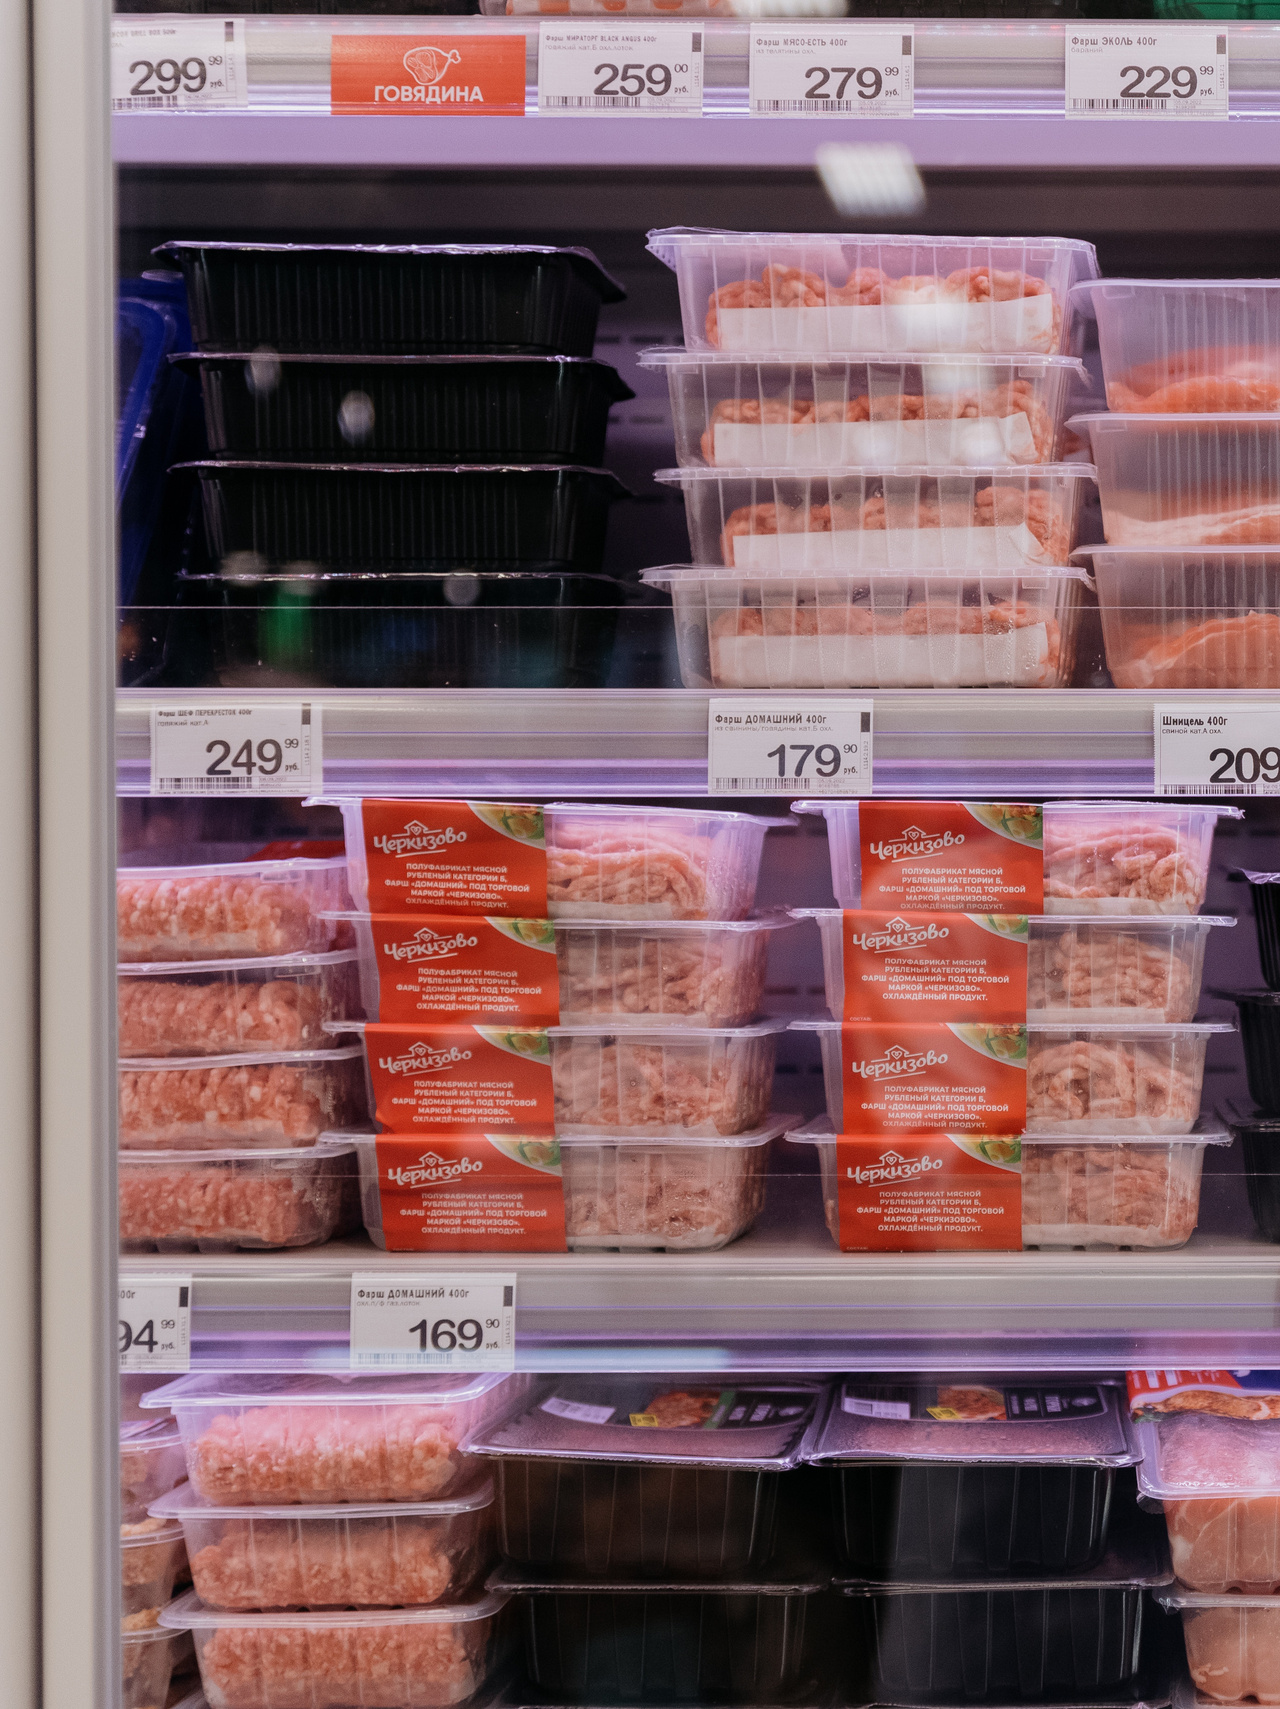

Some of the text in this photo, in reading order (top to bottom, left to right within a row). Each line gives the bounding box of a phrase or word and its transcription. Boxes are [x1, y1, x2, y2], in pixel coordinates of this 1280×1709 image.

[756, 39, 779, 47] Фарш
[1072, 37, 1098, 46] Фарш
[1102, 37, 1133, 45] ЭКОЛЬ
[130, 56, 222, 95] 299 99
[594, 63, 688, 96] 259 00
[805, 67, 899, 99] 279 99
[1120, 66, 1214, 98] 229 99
[375, 85, 483, 104] ГОВЯДИНА
[715, 715, 742, 724] Фарш
[745, 714, 802, 724] ДОМАШНИЙ
[1162, 717, 1228, 726] Шницель 400г
[206, 738, 299, 775] 249 99
[767, 744, 857, 777] 179 90
[373, 827, 467, 853] Черкизово
[870, 831, 965, 860] Черкизово
[968, 867, 1003, 875] МЯСНОЙ
[905, 885, 962, 893] «ДОМАШНИЙ»
[984, 885, 1025, 893] ТОРГОВОЙ
[942, 894, 999, 902] «ЧЕРКИЗОВО».
[853, 924, 949, 950] Черкизово
[852, 1050, 948, 1078] Черкизово
[847, 1156, 942, 1184] Черкизово
[358, 1288, 469, 1299] Фарш ДОМАШНИЙ 400г
[409, 1319, 499, 1352] 169 90
